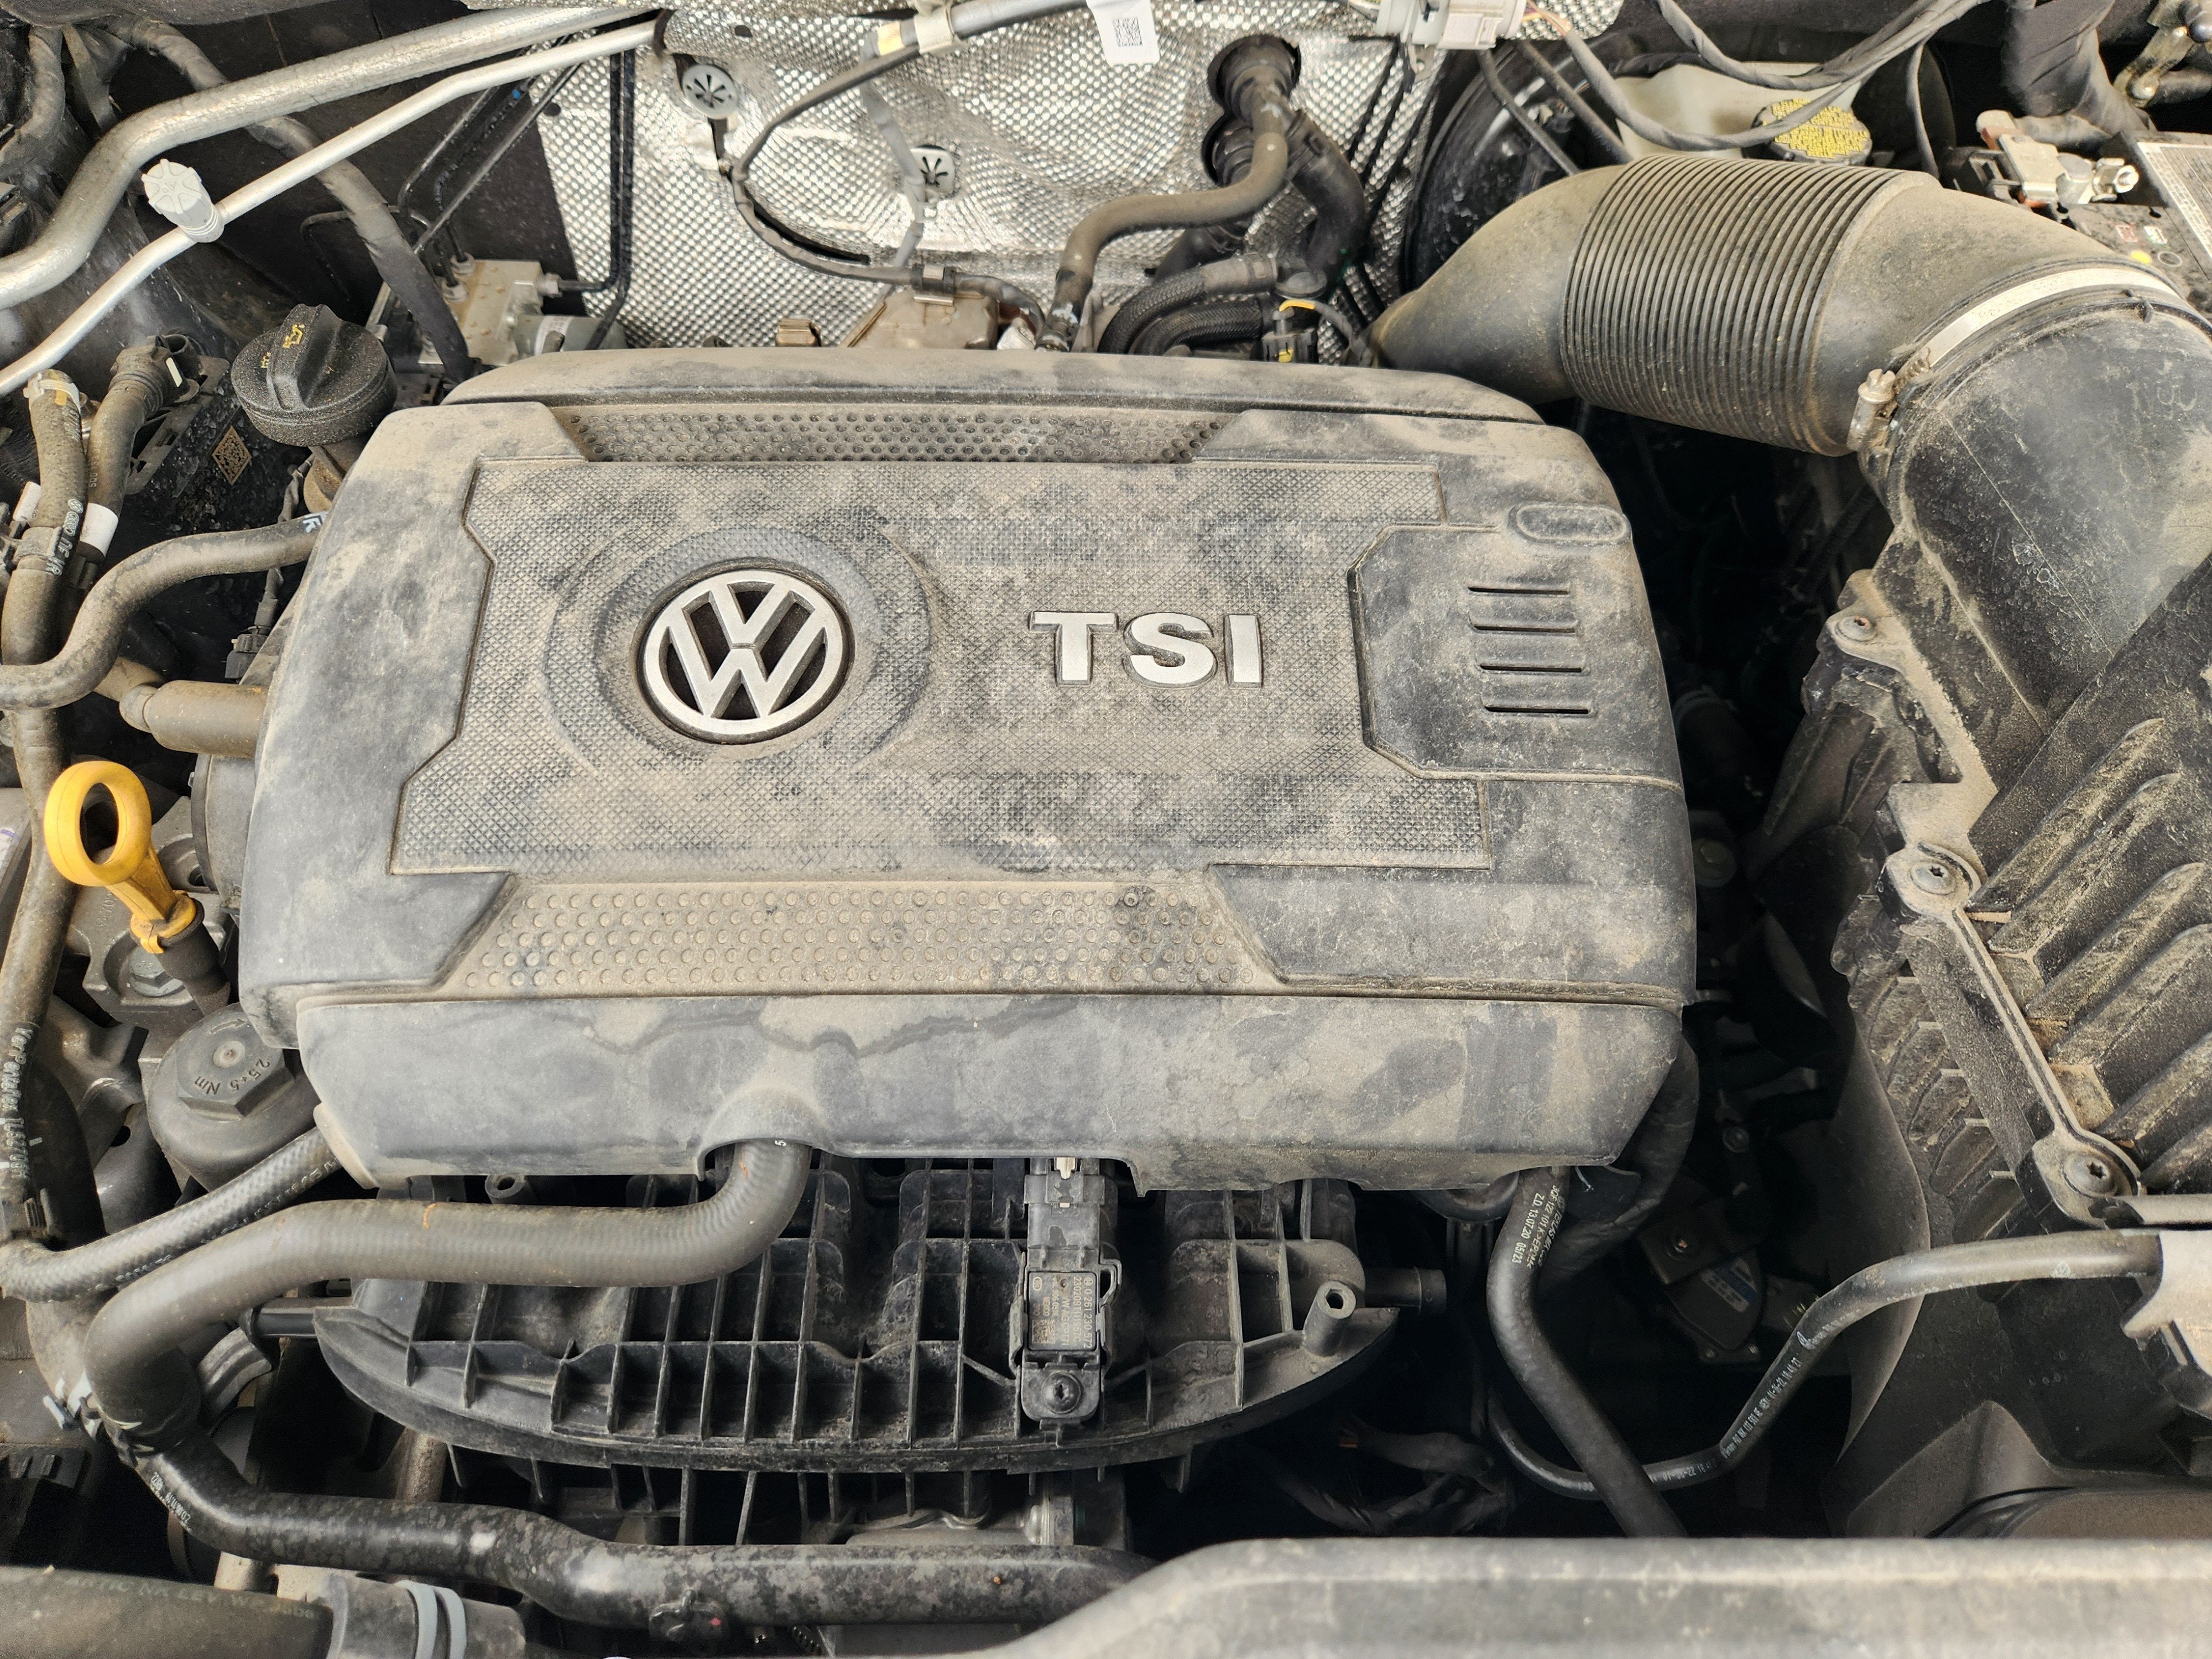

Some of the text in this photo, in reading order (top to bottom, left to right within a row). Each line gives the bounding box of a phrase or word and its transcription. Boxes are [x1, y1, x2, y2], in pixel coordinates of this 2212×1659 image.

[1030, 611, 1263, 688] TSI
[195, 1076, 221, 1095] Nm
[1550, 1185, 1559, 1202] 3QF
[1545, 1201, 1555, 1214] 122
[1540, 1214, 1550, 1228] 101
[1537, 1227, 1545, 1235] K
[1084, 1297, 1093, 1311] 261
[1084, 1314, 1093, 1331] 230
[1083, 1333, 1092, 1349] 572
